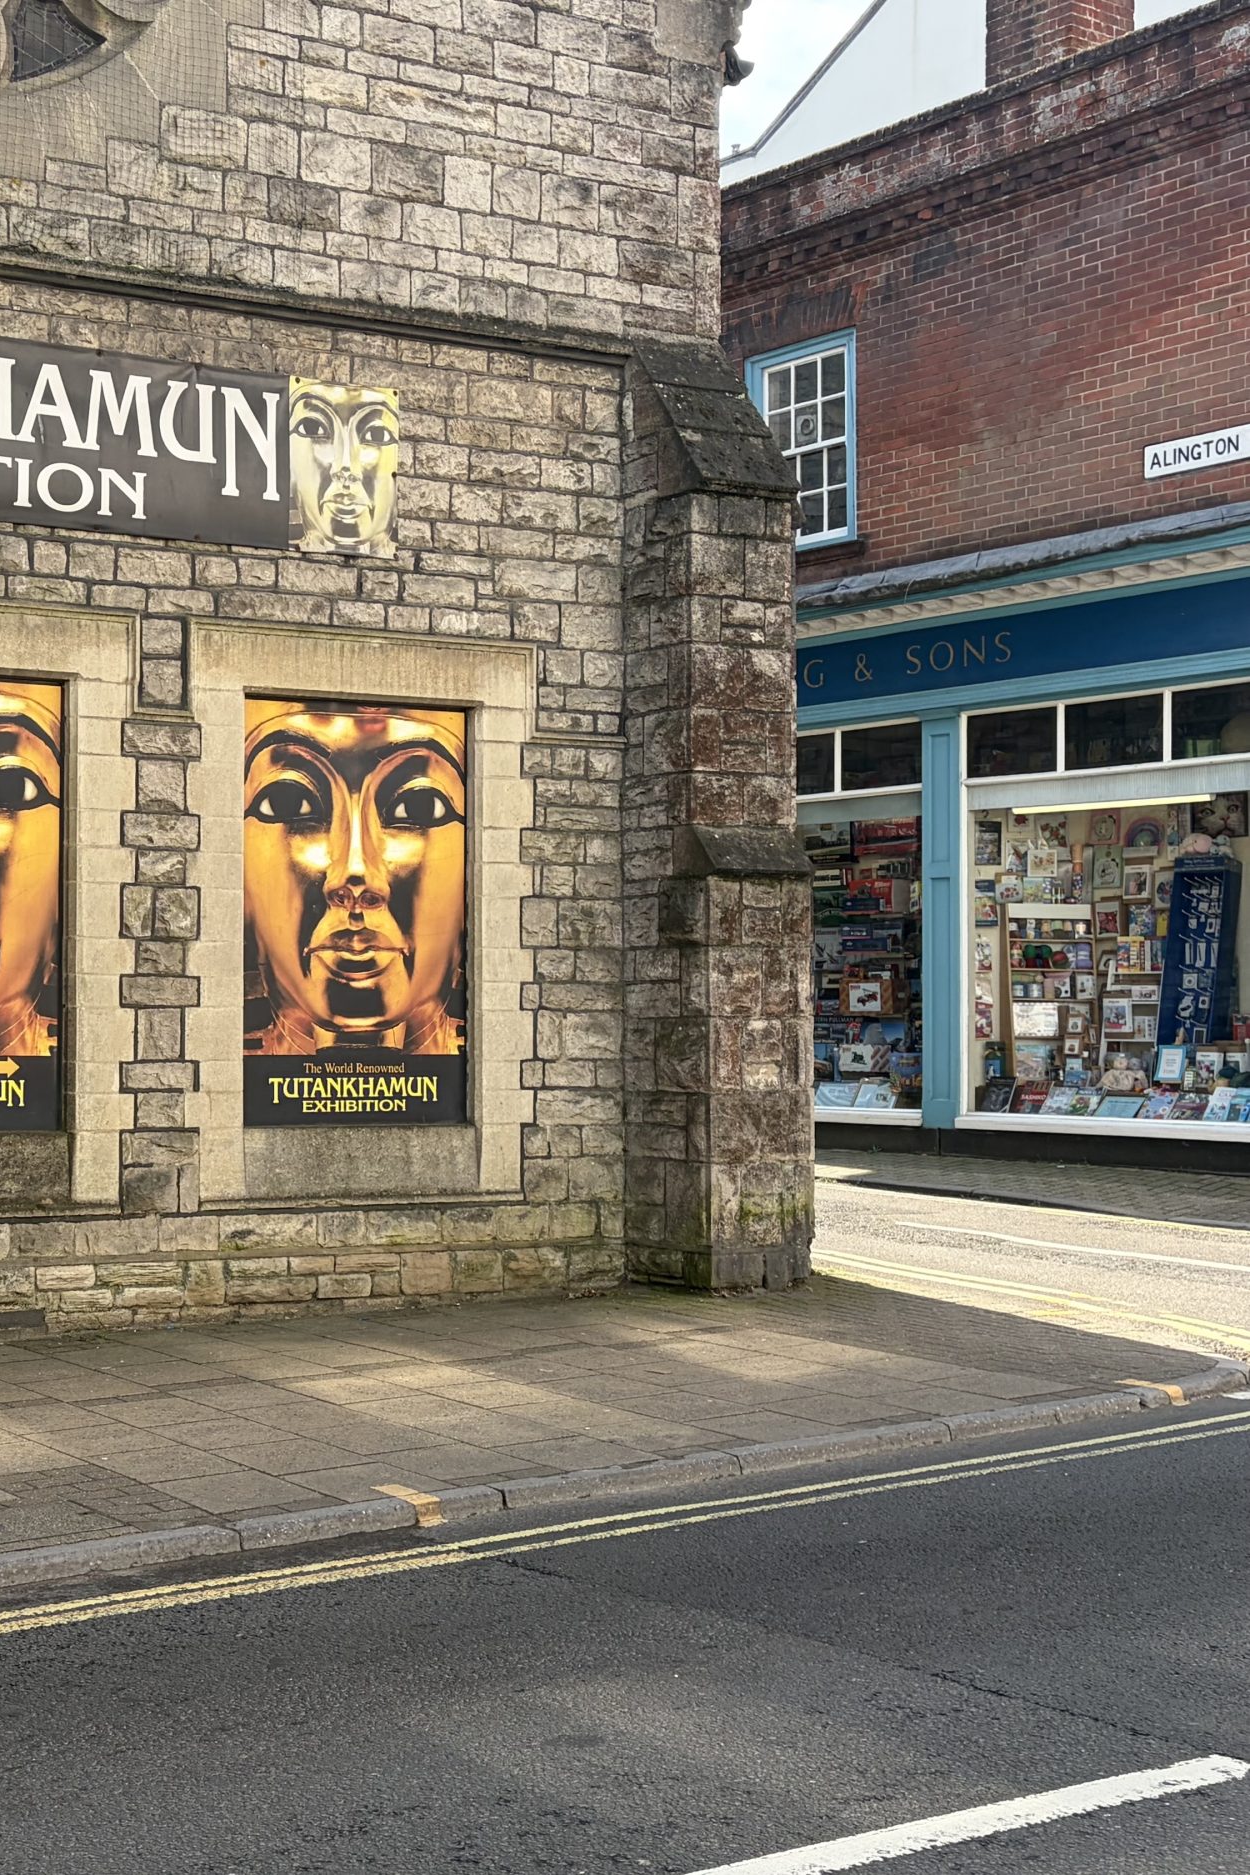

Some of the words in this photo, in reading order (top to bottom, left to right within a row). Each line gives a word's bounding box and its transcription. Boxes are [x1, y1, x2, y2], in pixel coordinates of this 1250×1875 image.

[1150, 434, 1240, 470] ALINGTON
[854, 653, 873, 682] &
[906, 631, 1012, 675] SONS
[303, 1062, 322, 1074] The
[324, 1062, 353, 1074] World
[356, 1062, 405, 1074] Renowned
[268, 1076, 438, 1104] TUTANKHAMUN
[302, 1099, 406, 1113] EXHIBITION
